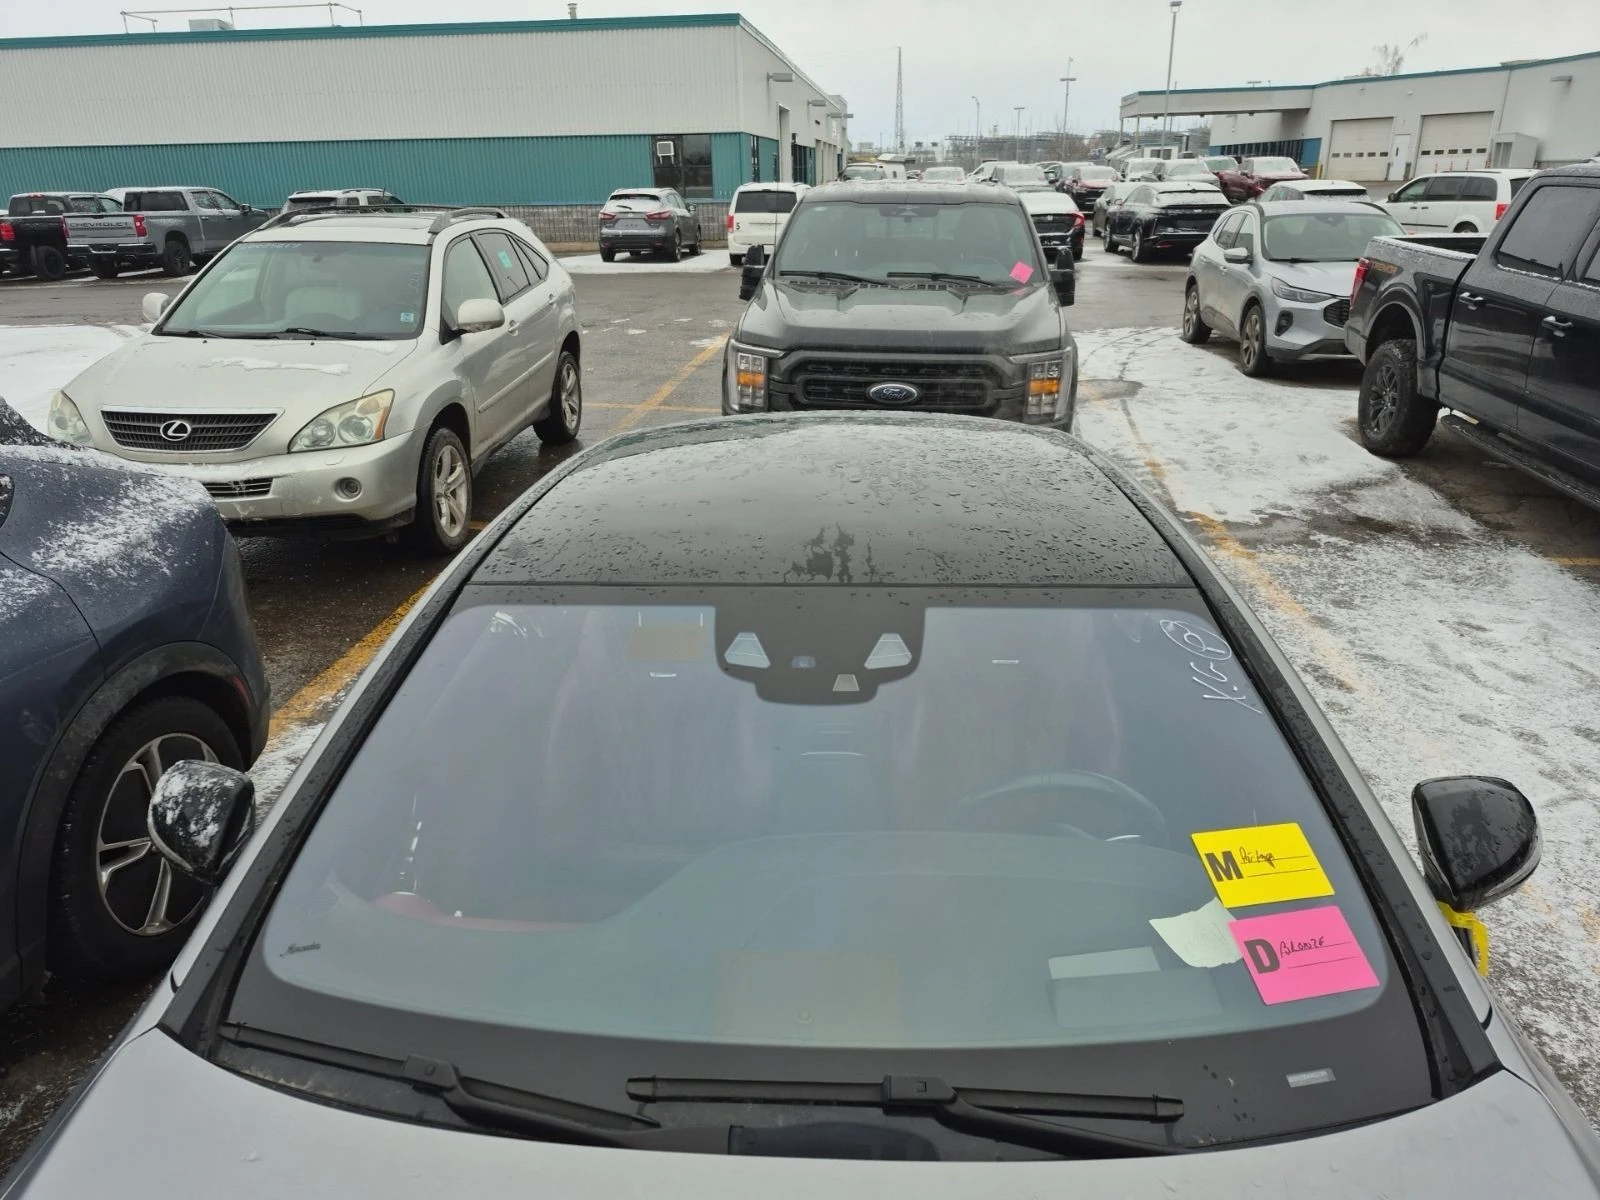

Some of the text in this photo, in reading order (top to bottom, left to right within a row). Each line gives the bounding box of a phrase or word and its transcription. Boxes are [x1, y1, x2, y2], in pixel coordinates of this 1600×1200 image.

[881, 387, 906, 399] Ford
[1204, 850, 1244, 882] M
[1243, 938, 1281, 975] D
